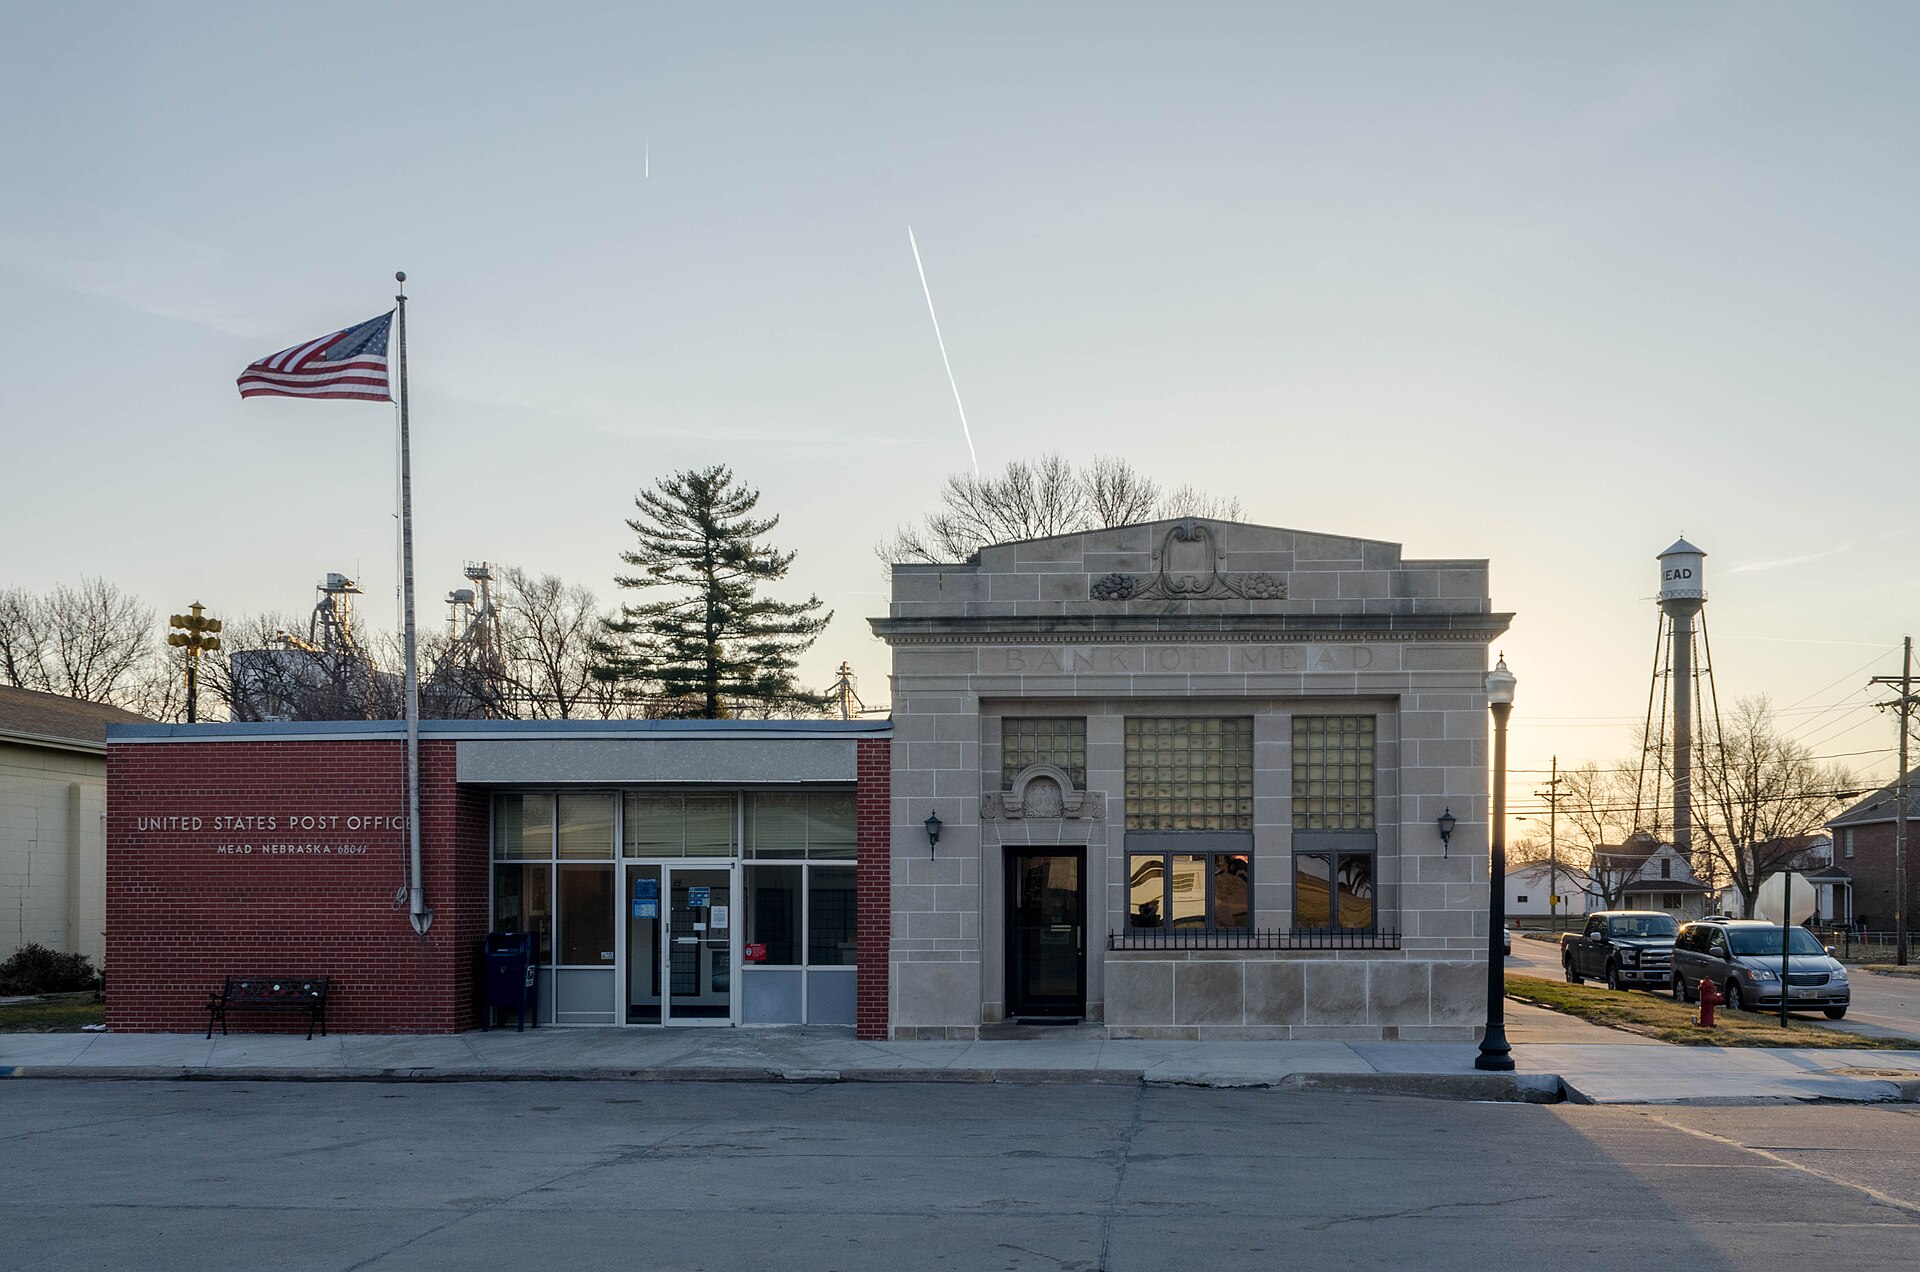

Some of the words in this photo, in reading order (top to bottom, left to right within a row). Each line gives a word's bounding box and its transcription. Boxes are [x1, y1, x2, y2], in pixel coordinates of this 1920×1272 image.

[1663, 569, 1692, 582] EAD
[1005, 648, 1131, 673] BANK
[1159, 648, 1208, 672] OF
[1240, 646, 1374, 671] MEAD
[137, 817, 203, 831] UNITED
[213, 816, 277, 831] STATES
[289, 816, 339, 831] POST
[217, 844, 252, 854] MEAD
[262, 844, 331, 854] NEBRASKA
[337, 844, 367, 855] 68041
